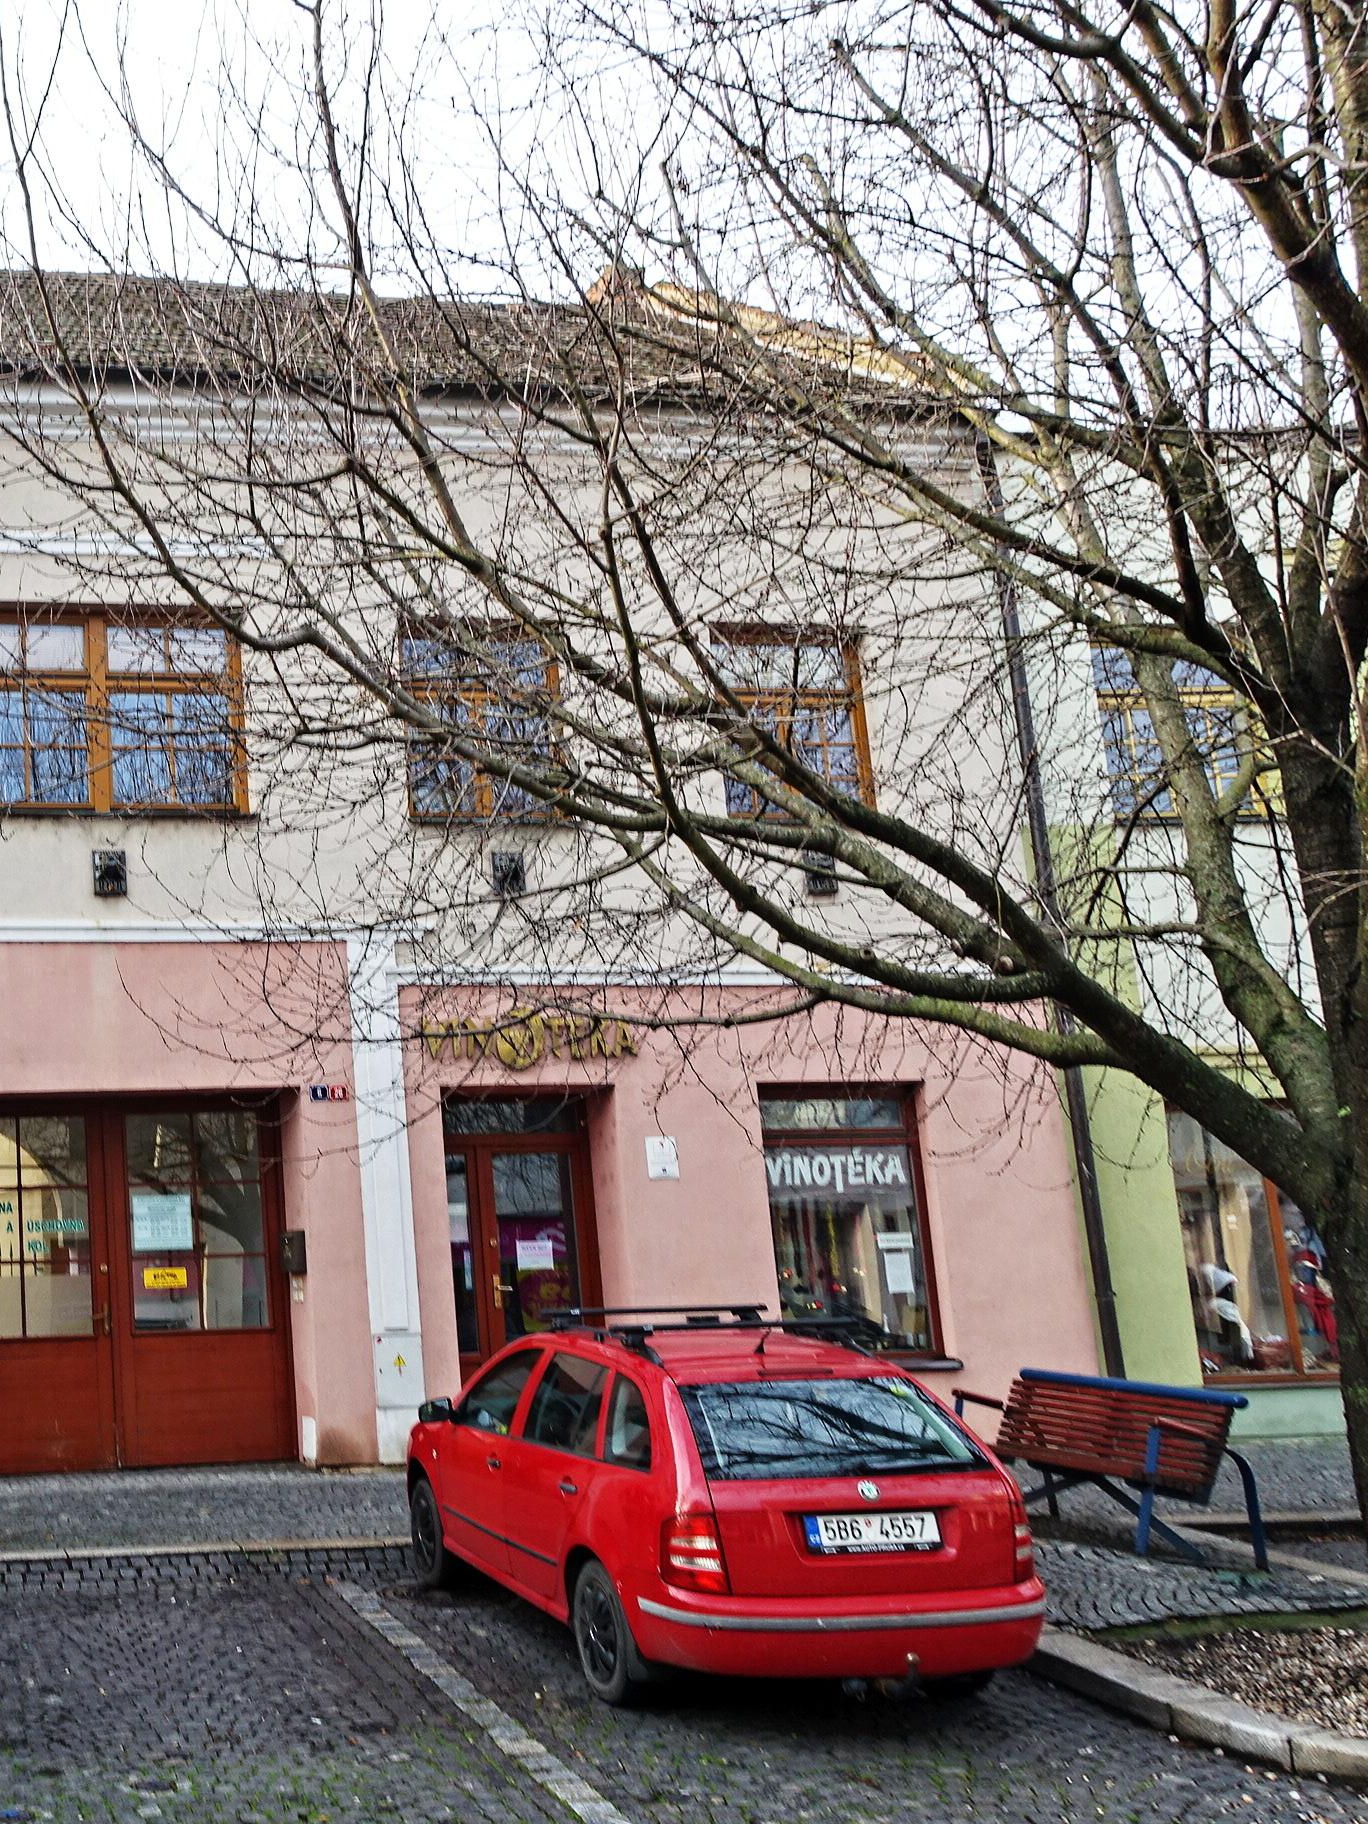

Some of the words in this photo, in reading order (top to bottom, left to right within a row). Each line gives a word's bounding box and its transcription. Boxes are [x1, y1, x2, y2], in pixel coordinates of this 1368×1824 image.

[6, 1221, 14, 1233] A
[823, 1519, 863, 1541] 5B6
[879, 1516, 925, 1540] 4557
